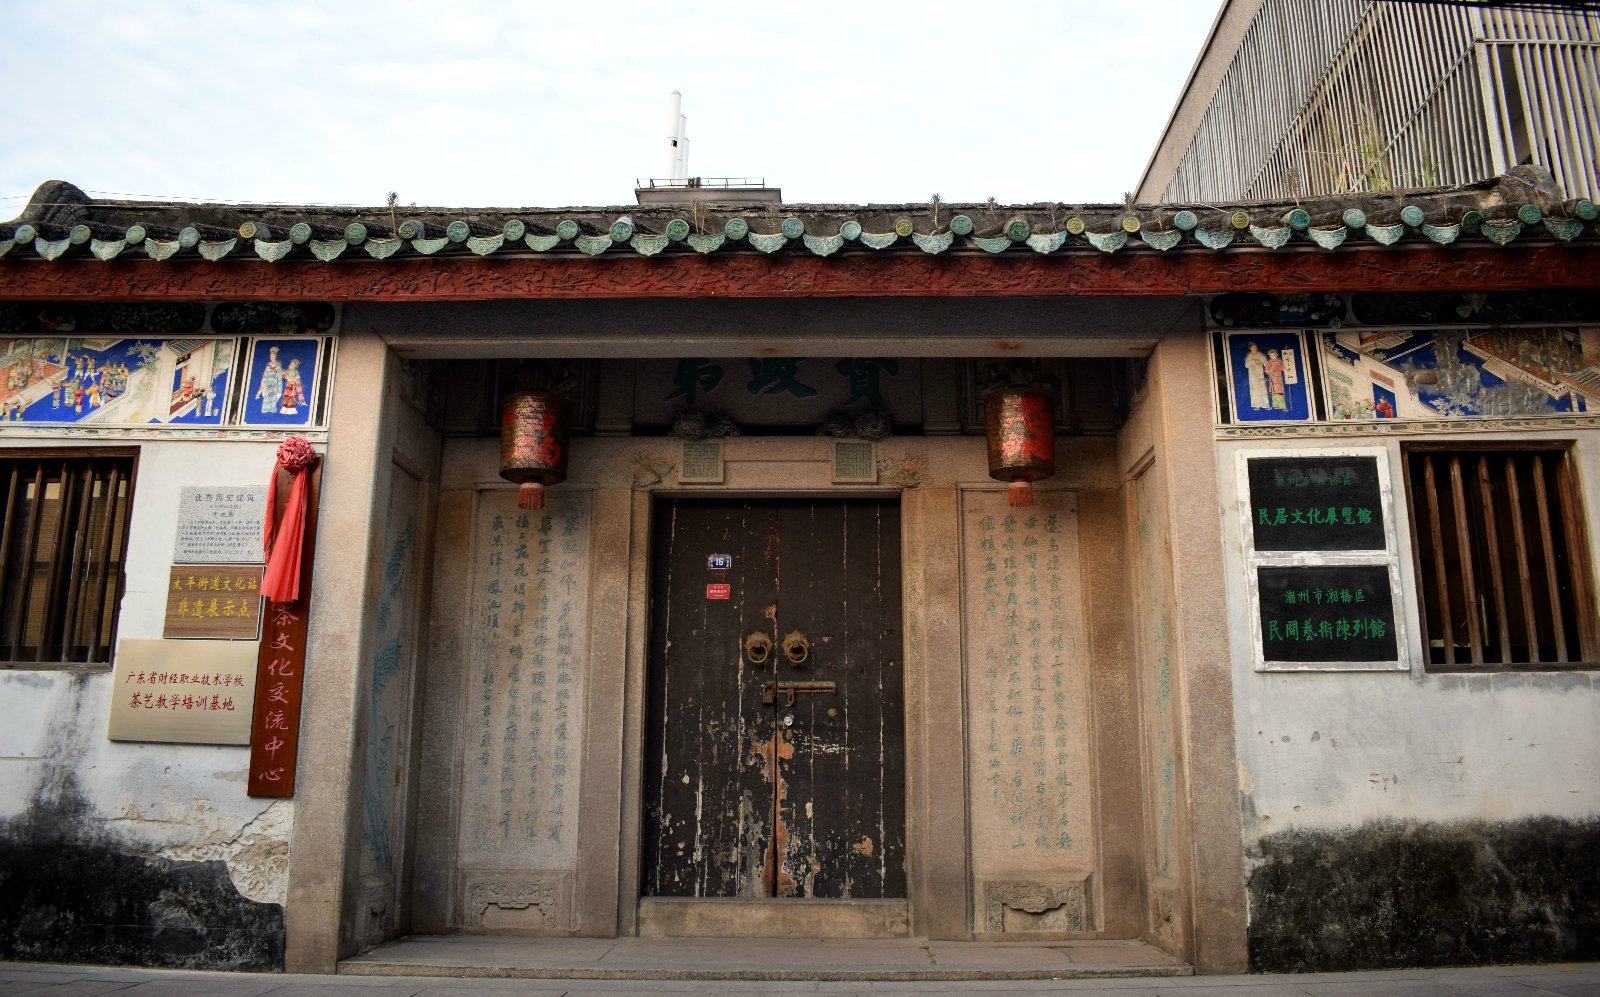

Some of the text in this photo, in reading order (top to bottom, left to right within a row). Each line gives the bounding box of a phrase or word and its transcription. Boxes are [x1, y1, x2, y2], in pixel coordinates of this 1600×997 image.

[715, 557, 724, 566] 16
[172, 575, 257, 591] 太平街道文化站
[177, 597, 250, 618] 非遗展示点
[1268, 617, 1387, 641] 民間藝術陳列館
[125, 670, 245, 687] 广东省财经职业技术学校
[128, 691, 235, 711] 茶艺教学培训基地
